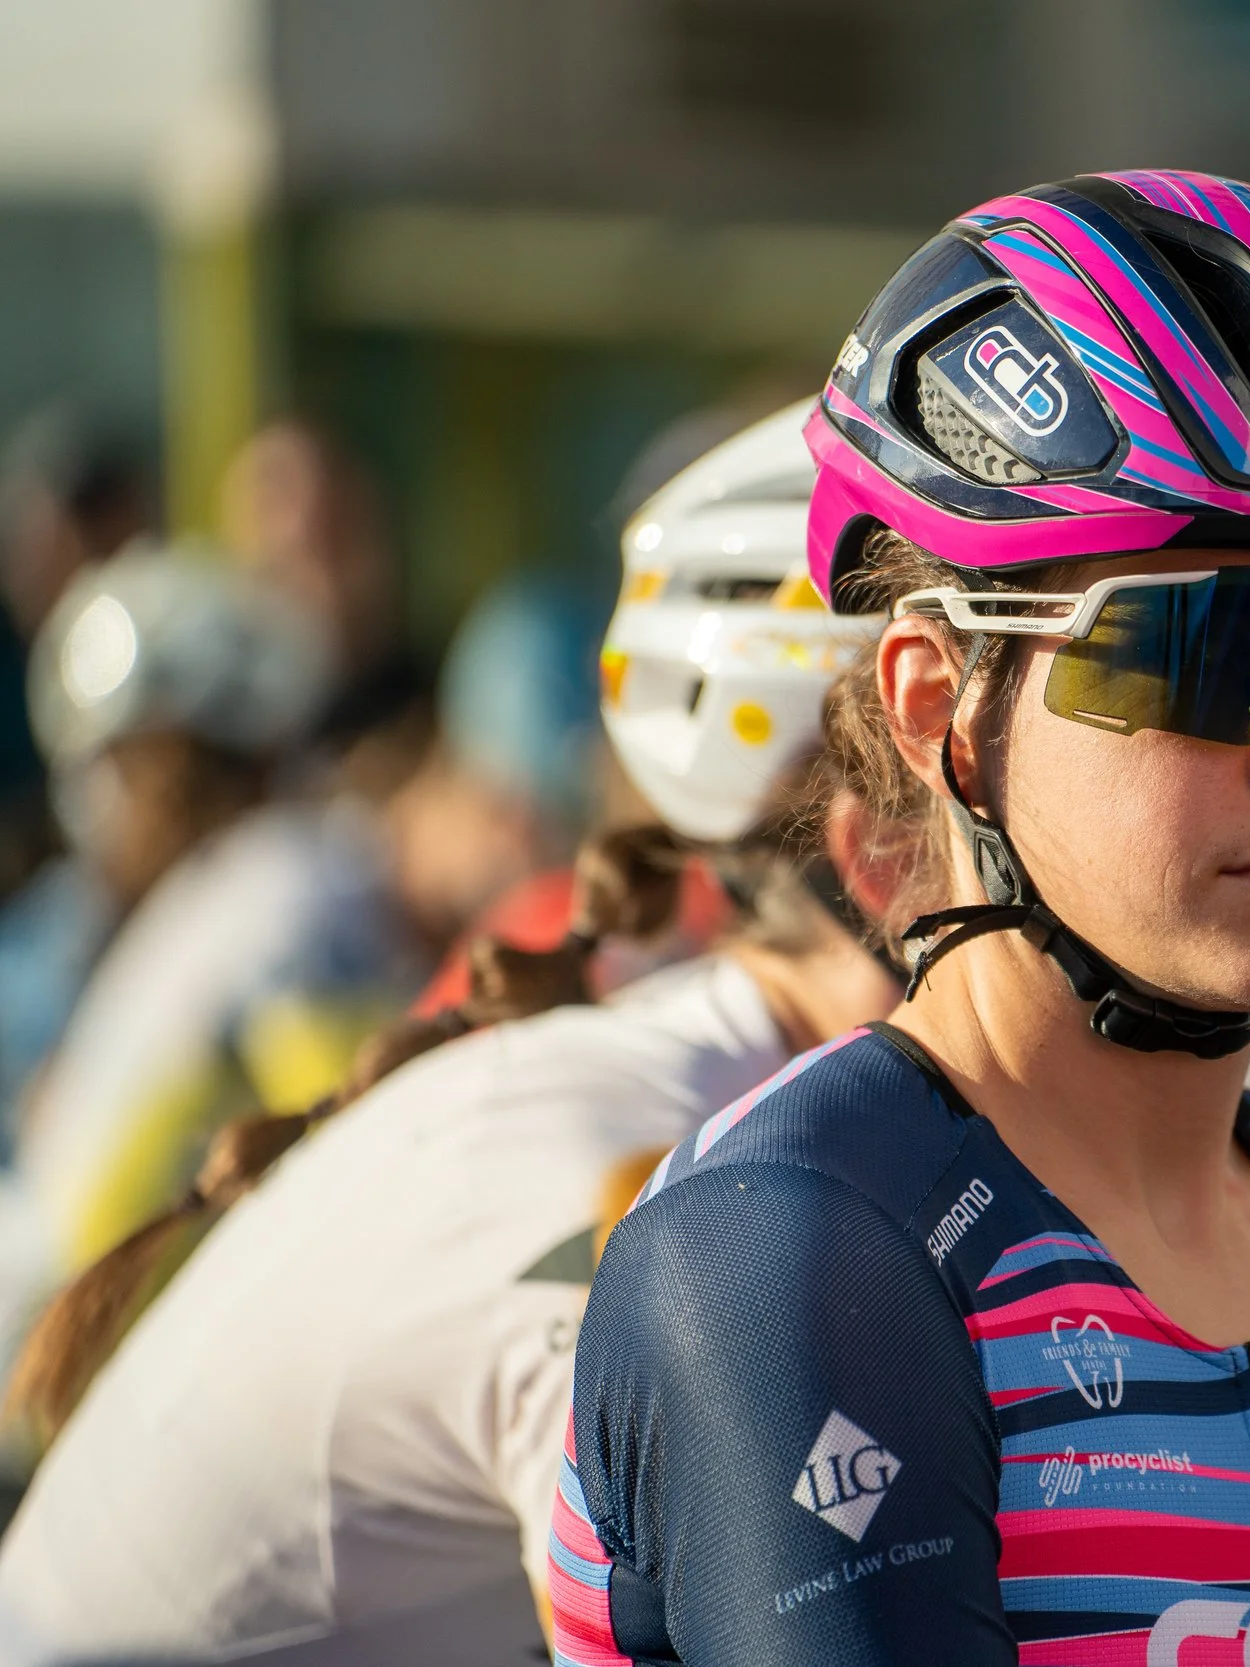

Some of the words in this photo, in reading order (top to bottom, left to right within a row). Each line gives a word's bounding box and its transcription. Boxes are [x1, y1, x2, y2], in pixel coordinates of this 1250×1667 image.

[1006, 622, 1045, 631] SHIMANO
[927, 1178, 994, 1268] SHIMANO
[1042, 1343, 1081, 1361] FRIENDS
[1082, 1338, 1099, 1359] &
[1098, 1342, 1131, 1358] FAMILY
[1088, 1448, 1194, 1477] procyclist
[1092, 1480, 1198, 1494] FOUNDATION
[774, 1571, 838, 1615] LEVINE
[842, 1553, 884, 1583] LAW
[888, 1537, 955, 1567] GROUP
